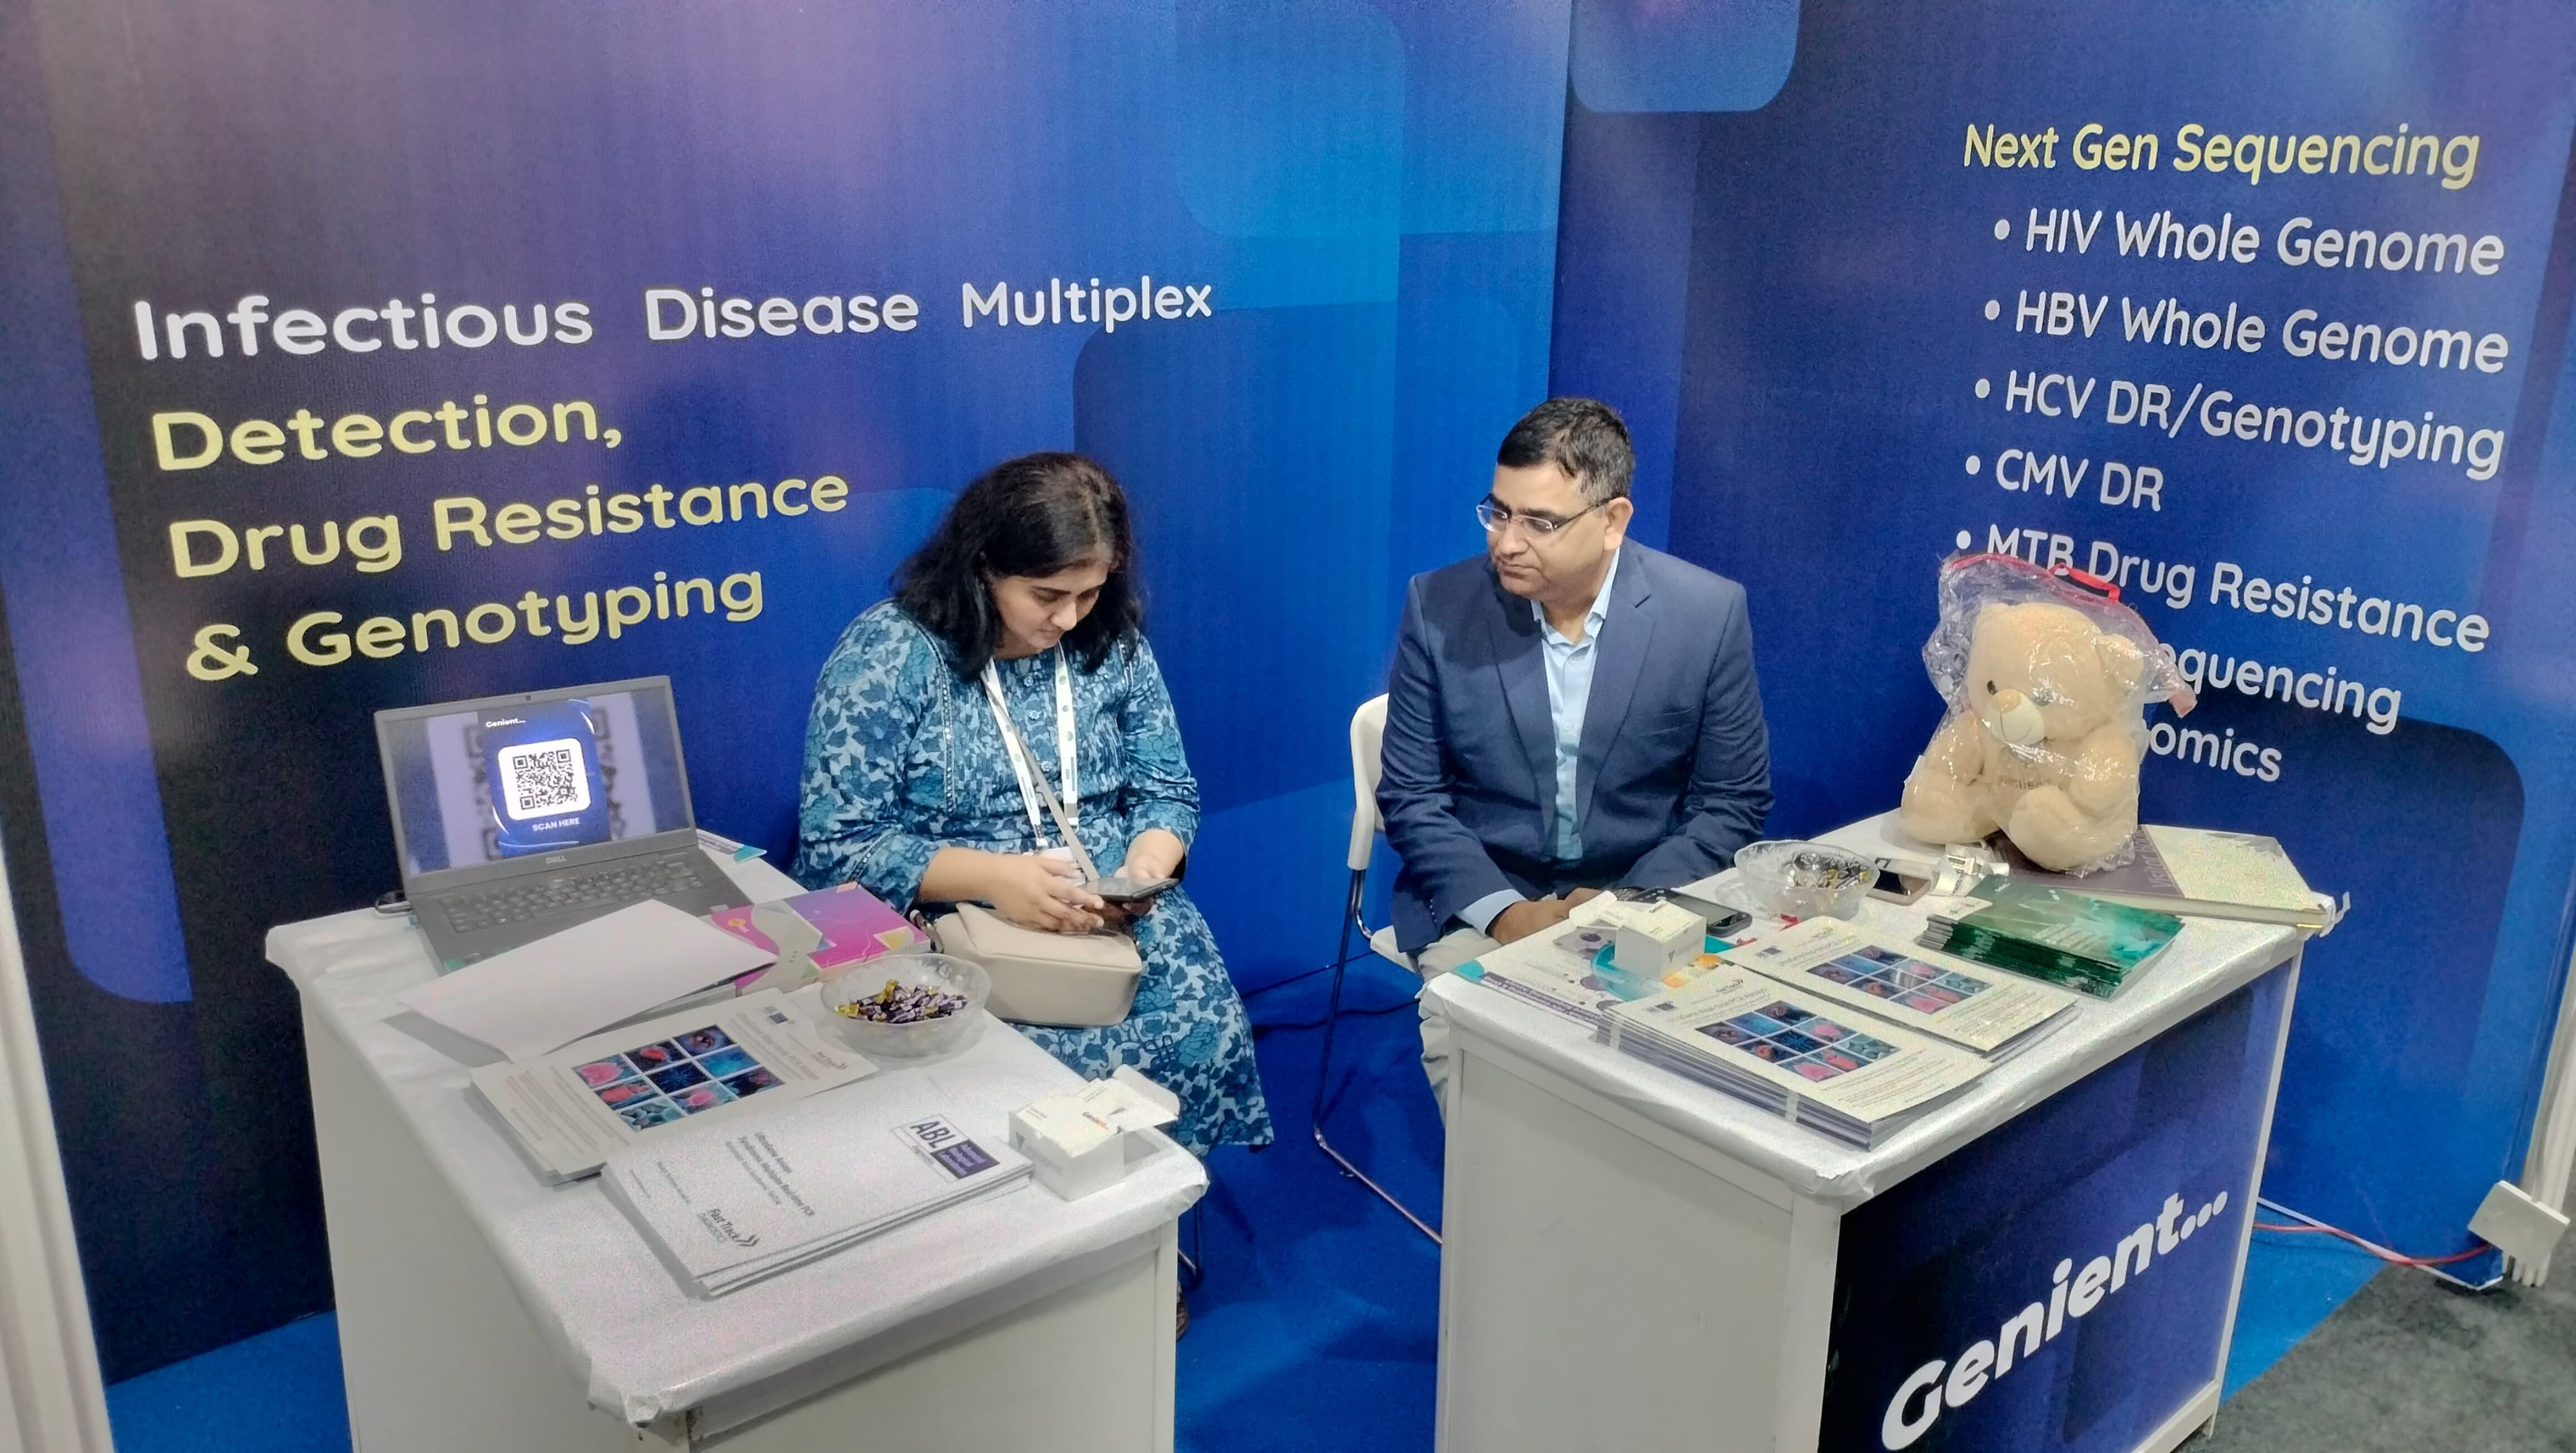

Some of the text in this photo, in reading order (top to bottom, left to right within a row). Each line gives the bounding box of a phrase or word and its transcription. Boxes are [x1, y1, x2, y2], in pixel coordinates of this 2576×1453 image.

[1964, 123, 2480, 190] Next Gen Sequencing
[2026, 207, 2504, 276] HIV Whole Genome
[134, 275, 1212, 360] Infectious Disease Multiplex
[2016, 290, 2509, 373] HBV Whole Genome
[152, 394, 622, 471] Detection,
[2006, 370, 2505, 481] HCV DR/Genotyping
[1996, 449, 2163, 512] CMV DR
[169, 476, 848, 578] Drug Resistance
[186, 570, 763, 681] & Genotyping
[1987, 524, 2489, 652] MTB Drug Resistance
[532, 817, 580, 831] SCAN HERE
[546, 855, 567, 864] DELL
[910, 1120, 957, 1148] ABL
[707, 1208, 742, 1240] Fast Track
[1882, 1190, 2229, 1451] Genient...
